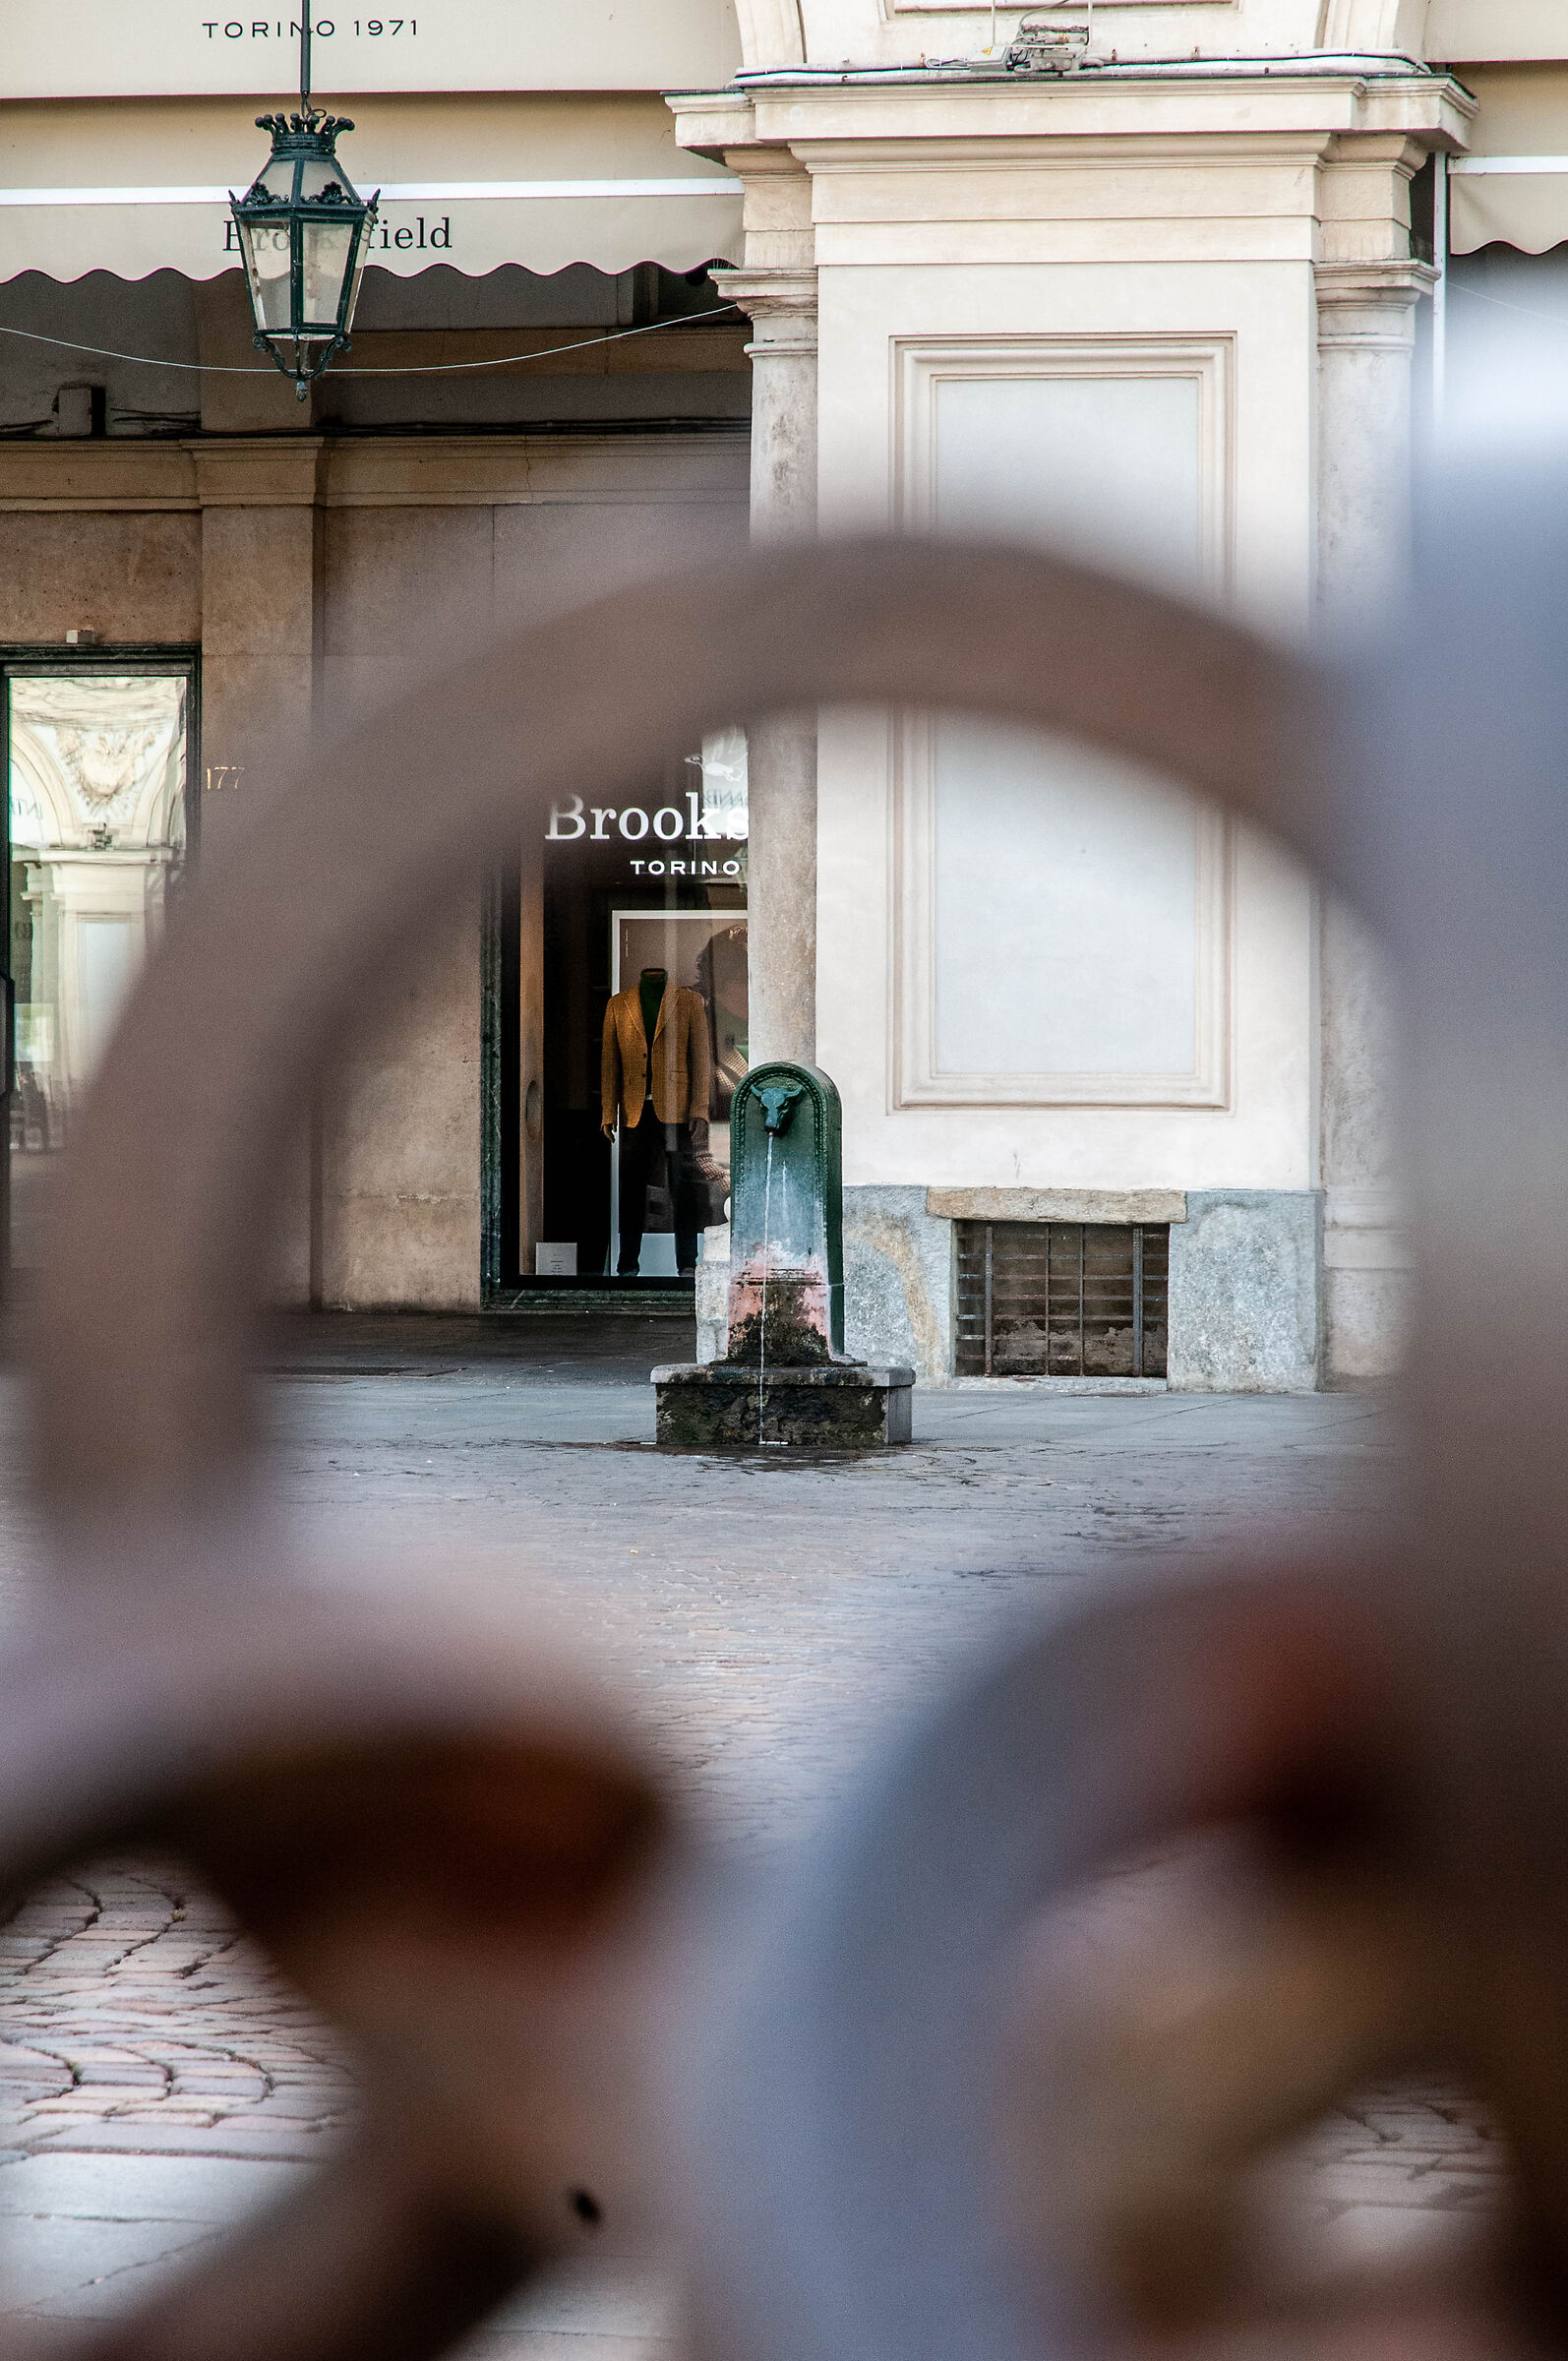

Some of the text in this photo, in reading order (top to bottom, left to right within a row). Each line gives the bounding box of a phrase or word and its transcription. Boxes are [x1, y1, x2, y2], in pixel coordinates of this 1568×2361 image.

[353, 19, 417, 36] 1971
[207, 766, 245, 790] 177
[630, 860, 741, 876] TORINO
